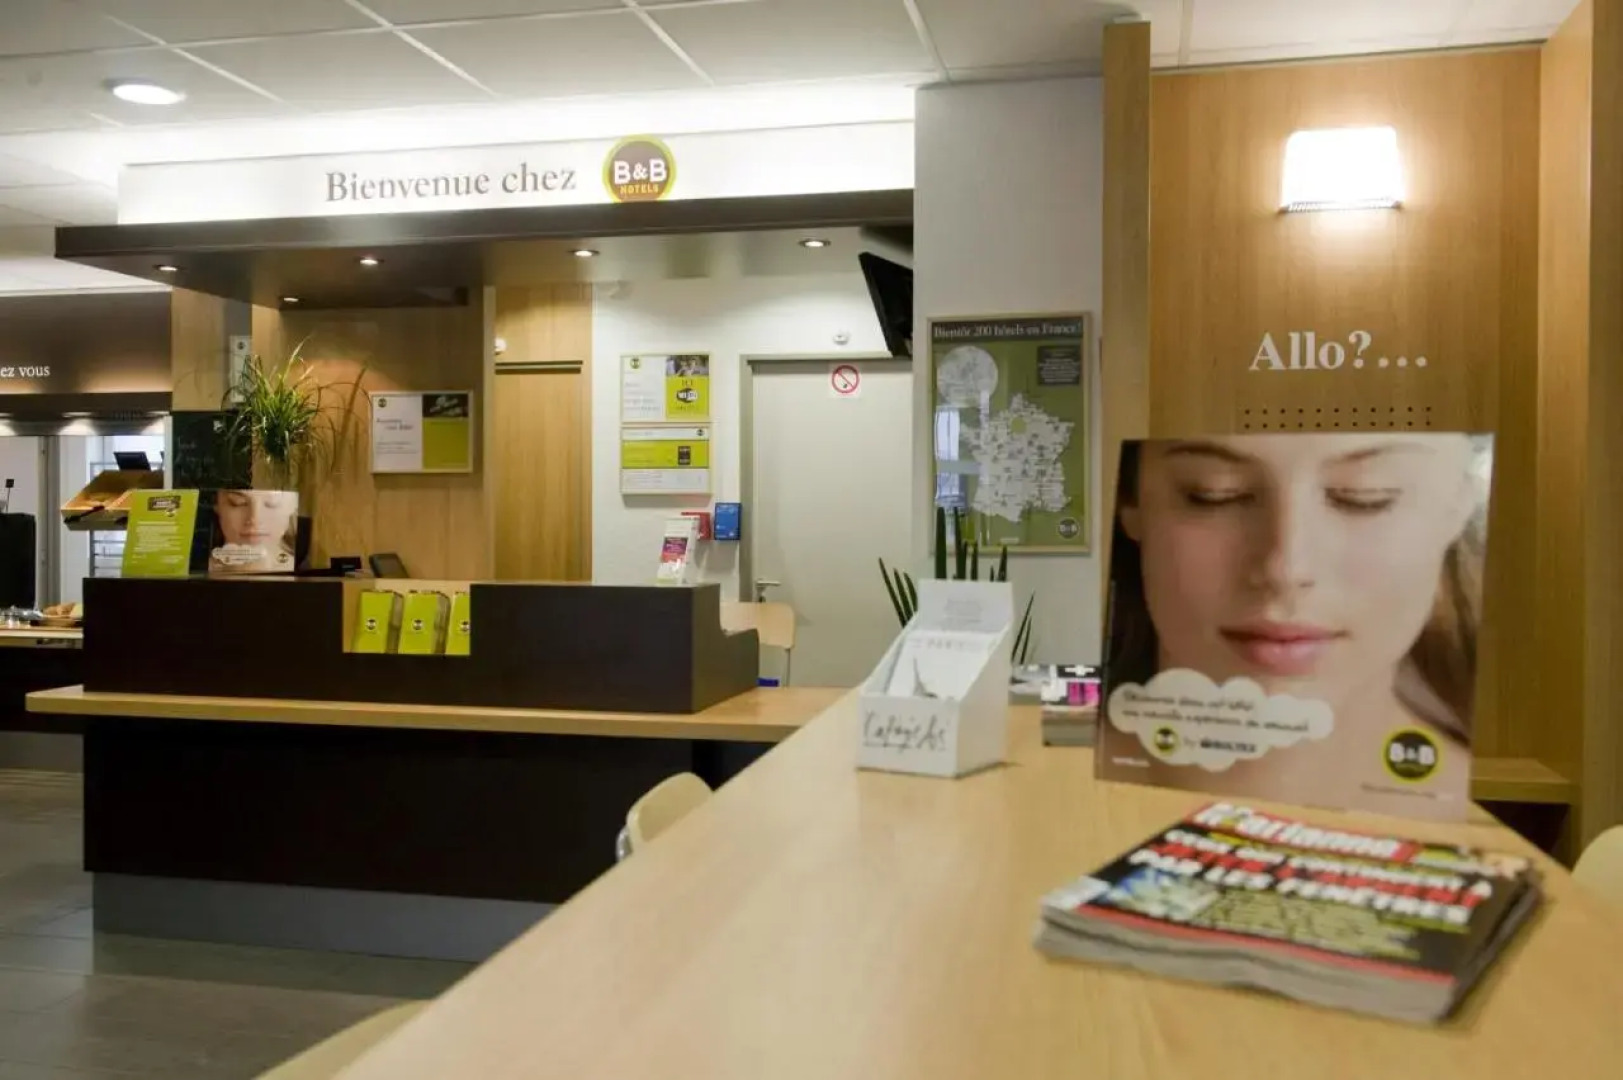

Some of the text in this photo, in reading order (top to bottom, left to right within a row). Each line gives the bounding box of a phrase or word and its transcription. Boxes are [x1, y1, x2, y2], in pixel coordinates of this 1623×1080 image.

[325, 162, 577, 201] Bienvenue chez
[613, 158, 667, 185] B&B
[620, 183, 659, 195] HOTELS
[19, 365, 50, 378] vous
